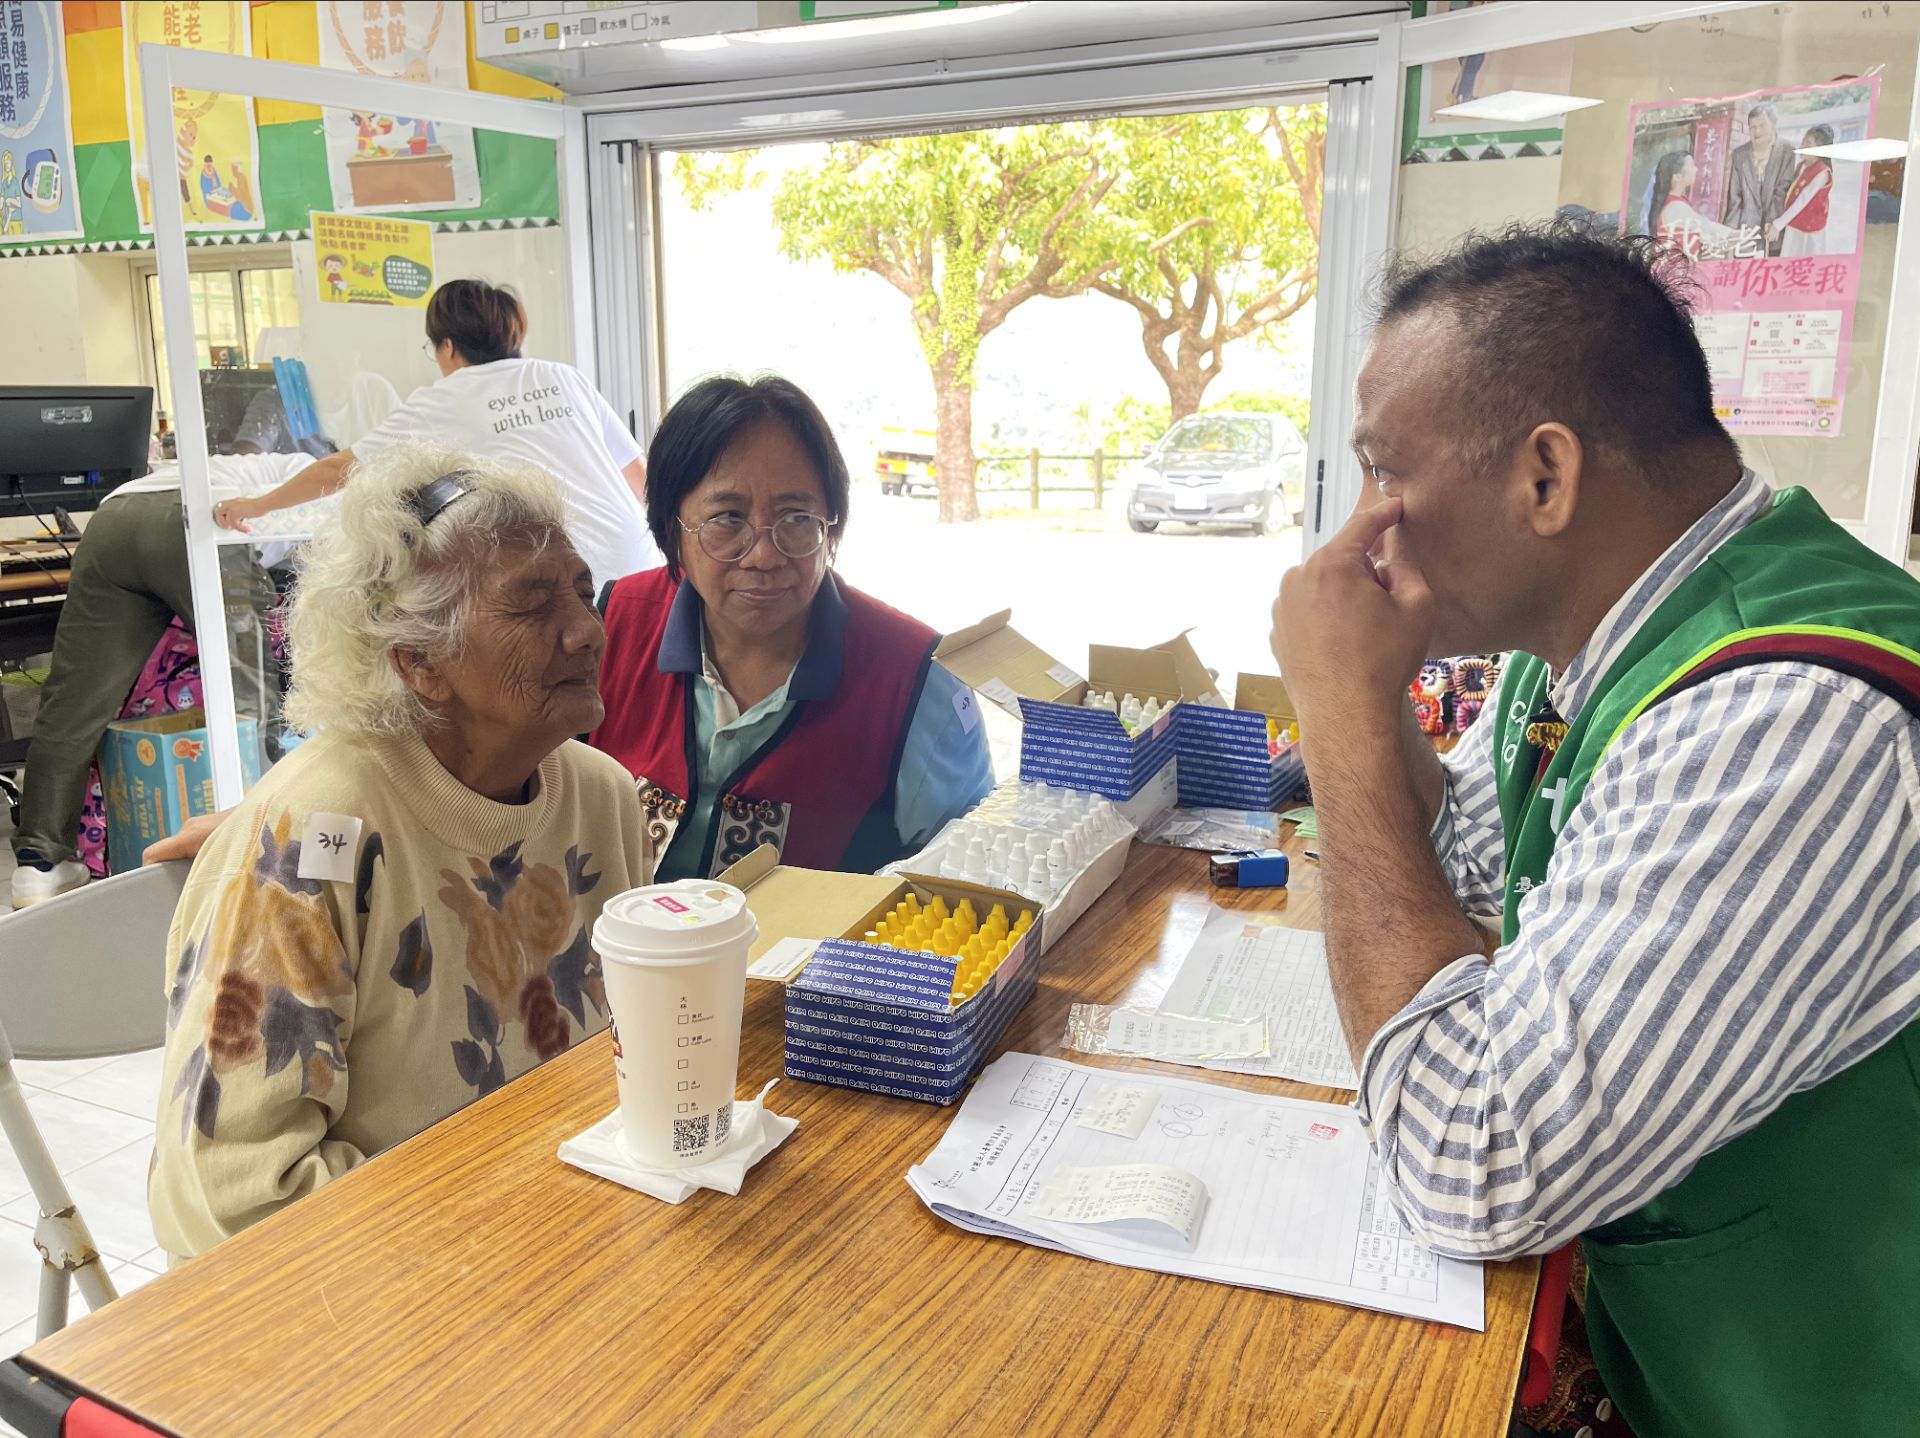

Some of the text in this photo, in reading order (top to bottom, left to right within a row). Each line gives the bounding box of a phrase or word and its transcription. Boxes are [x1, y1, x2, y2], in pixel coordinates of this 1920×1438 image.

[9, 0, 29, 99] 易健康
[1714, 256, 1847, 297] 請你愛我
[488, 385, 560, 411] eye care
[493, 405, 573, 433] with love
[318, 832, 348, 853] 34
[680, 996, 687, 1009] 大杯
